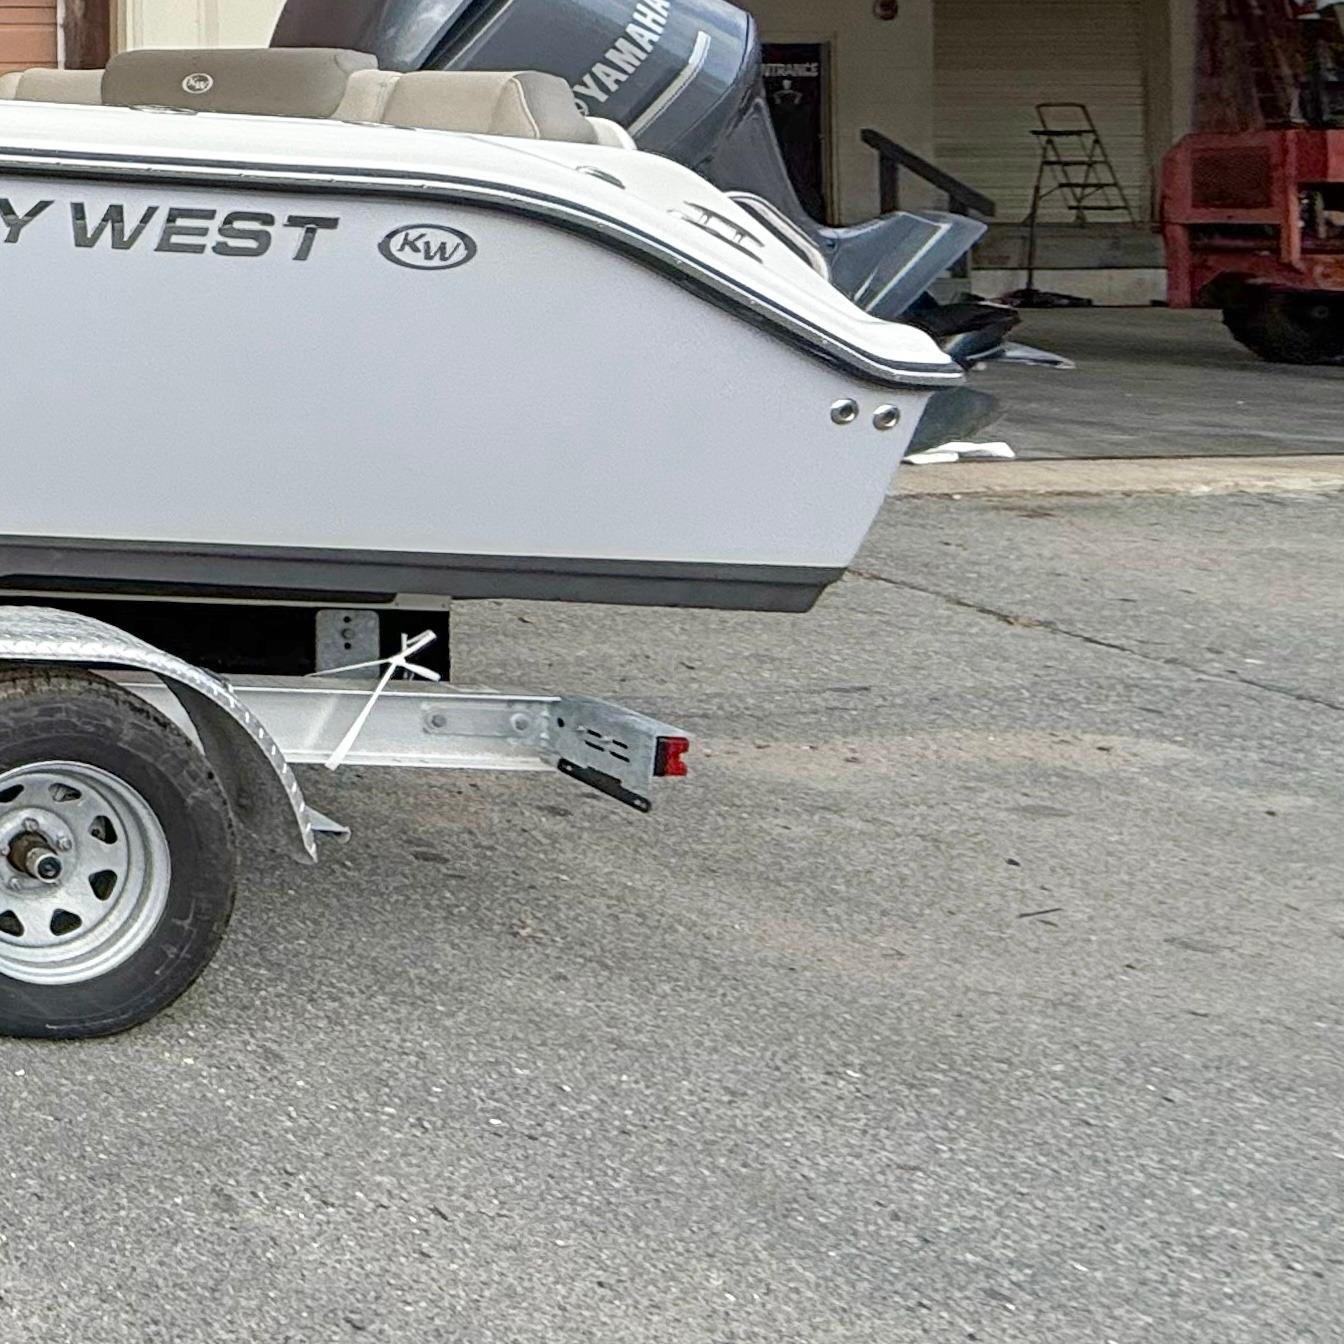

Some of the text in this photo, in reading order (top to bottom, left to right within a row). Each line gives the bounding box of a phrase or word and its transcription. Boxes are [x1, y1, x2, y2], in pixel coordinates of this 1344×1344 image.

[761, 62, 819, 77] NTRANCE
[70, 202, 340, 261] WEST
[396, 230, 461, 262] KW
